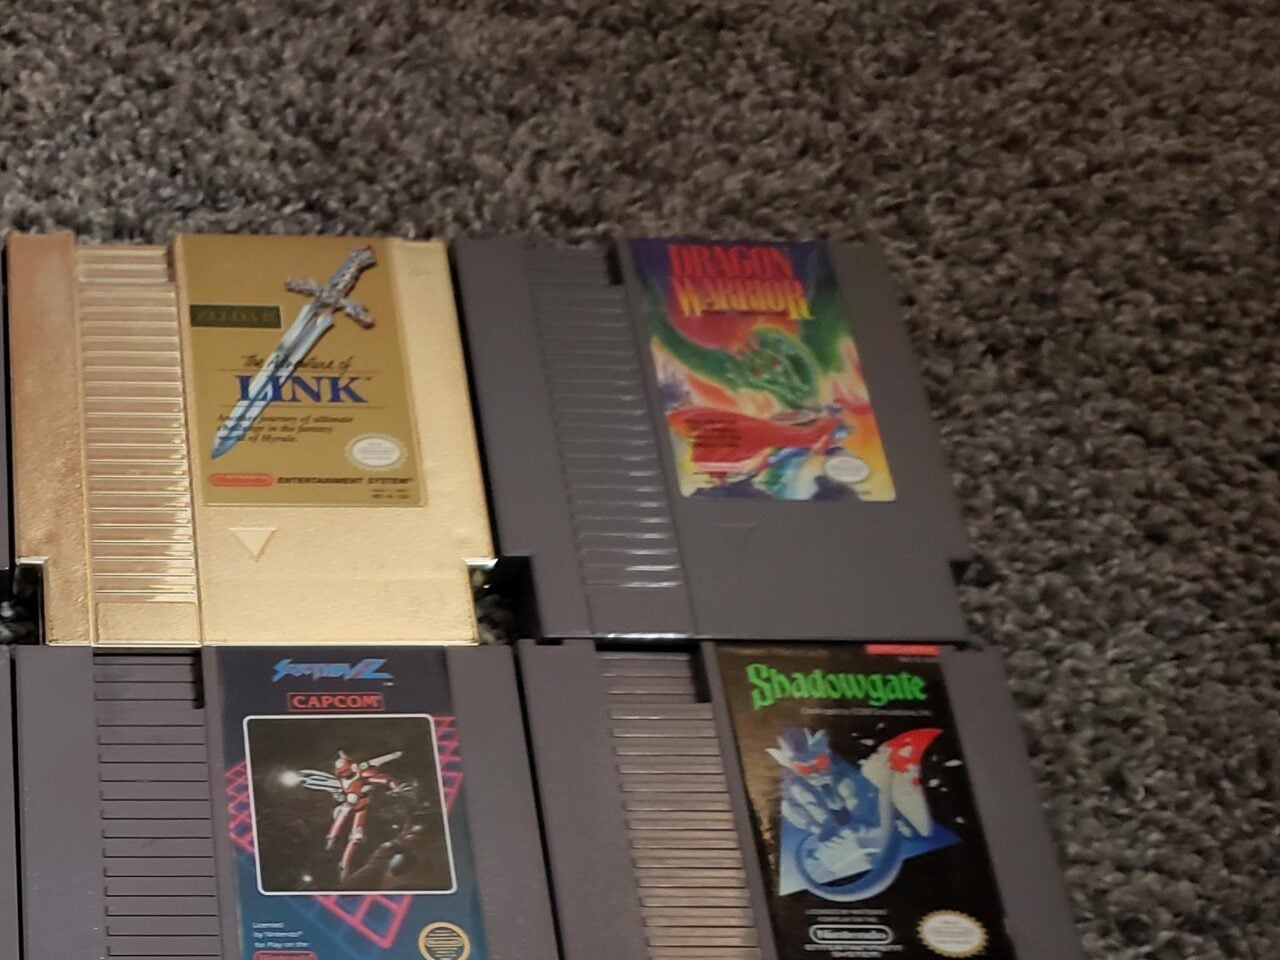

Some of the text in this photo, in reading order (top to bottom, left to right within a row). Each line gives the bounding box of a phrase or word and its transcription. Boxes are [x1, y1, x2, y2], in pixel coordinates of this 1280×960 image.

[235, 374, 369, 403] LINK
[746, 663, 928, 710] Shadowgate
[291, 695, 379, 708] CAPCOM
